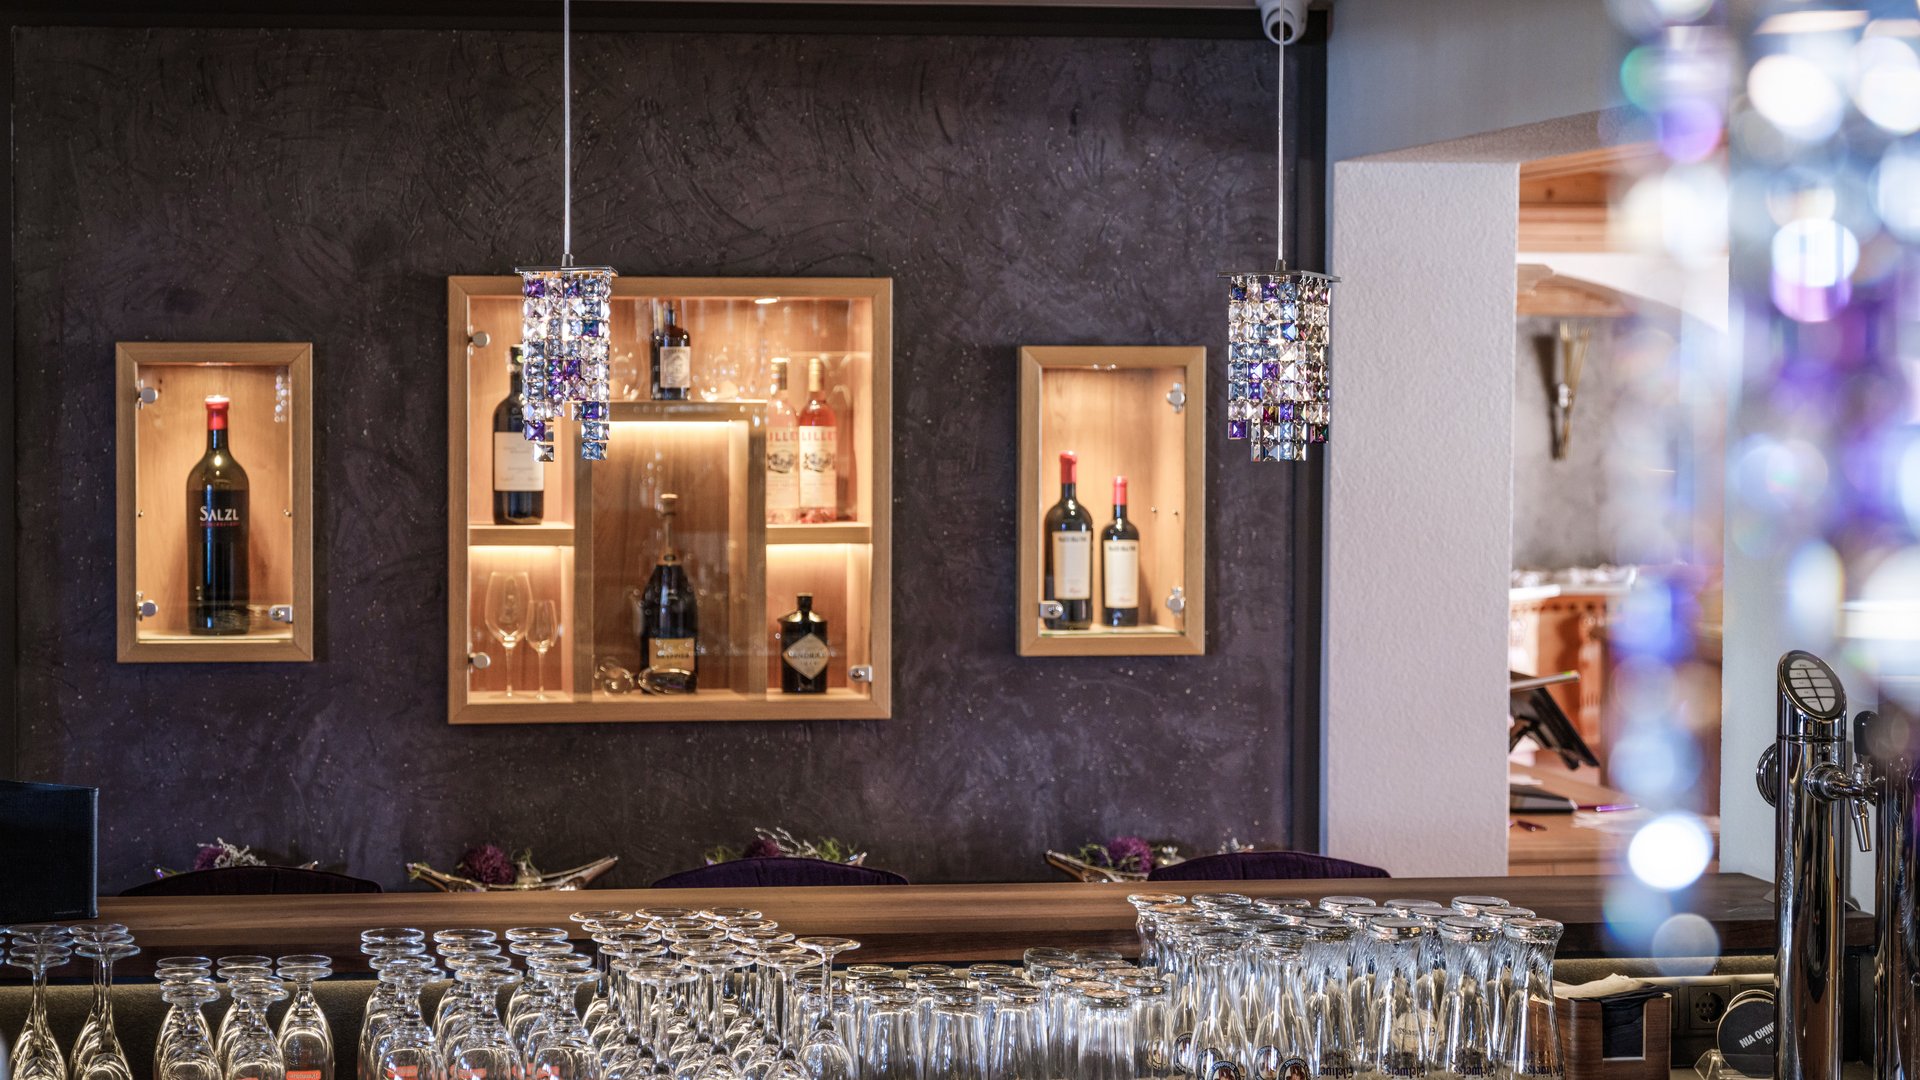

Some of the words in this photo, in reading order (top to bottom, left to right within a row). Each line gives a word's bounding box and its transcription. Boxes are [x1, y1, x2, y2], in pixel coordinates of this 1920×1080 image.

[199, 505, 239, 521] SALZL
[1739, 1034, 1756, 1049] NIA
[1320, 1065, 1354, 1079] Edelwe
